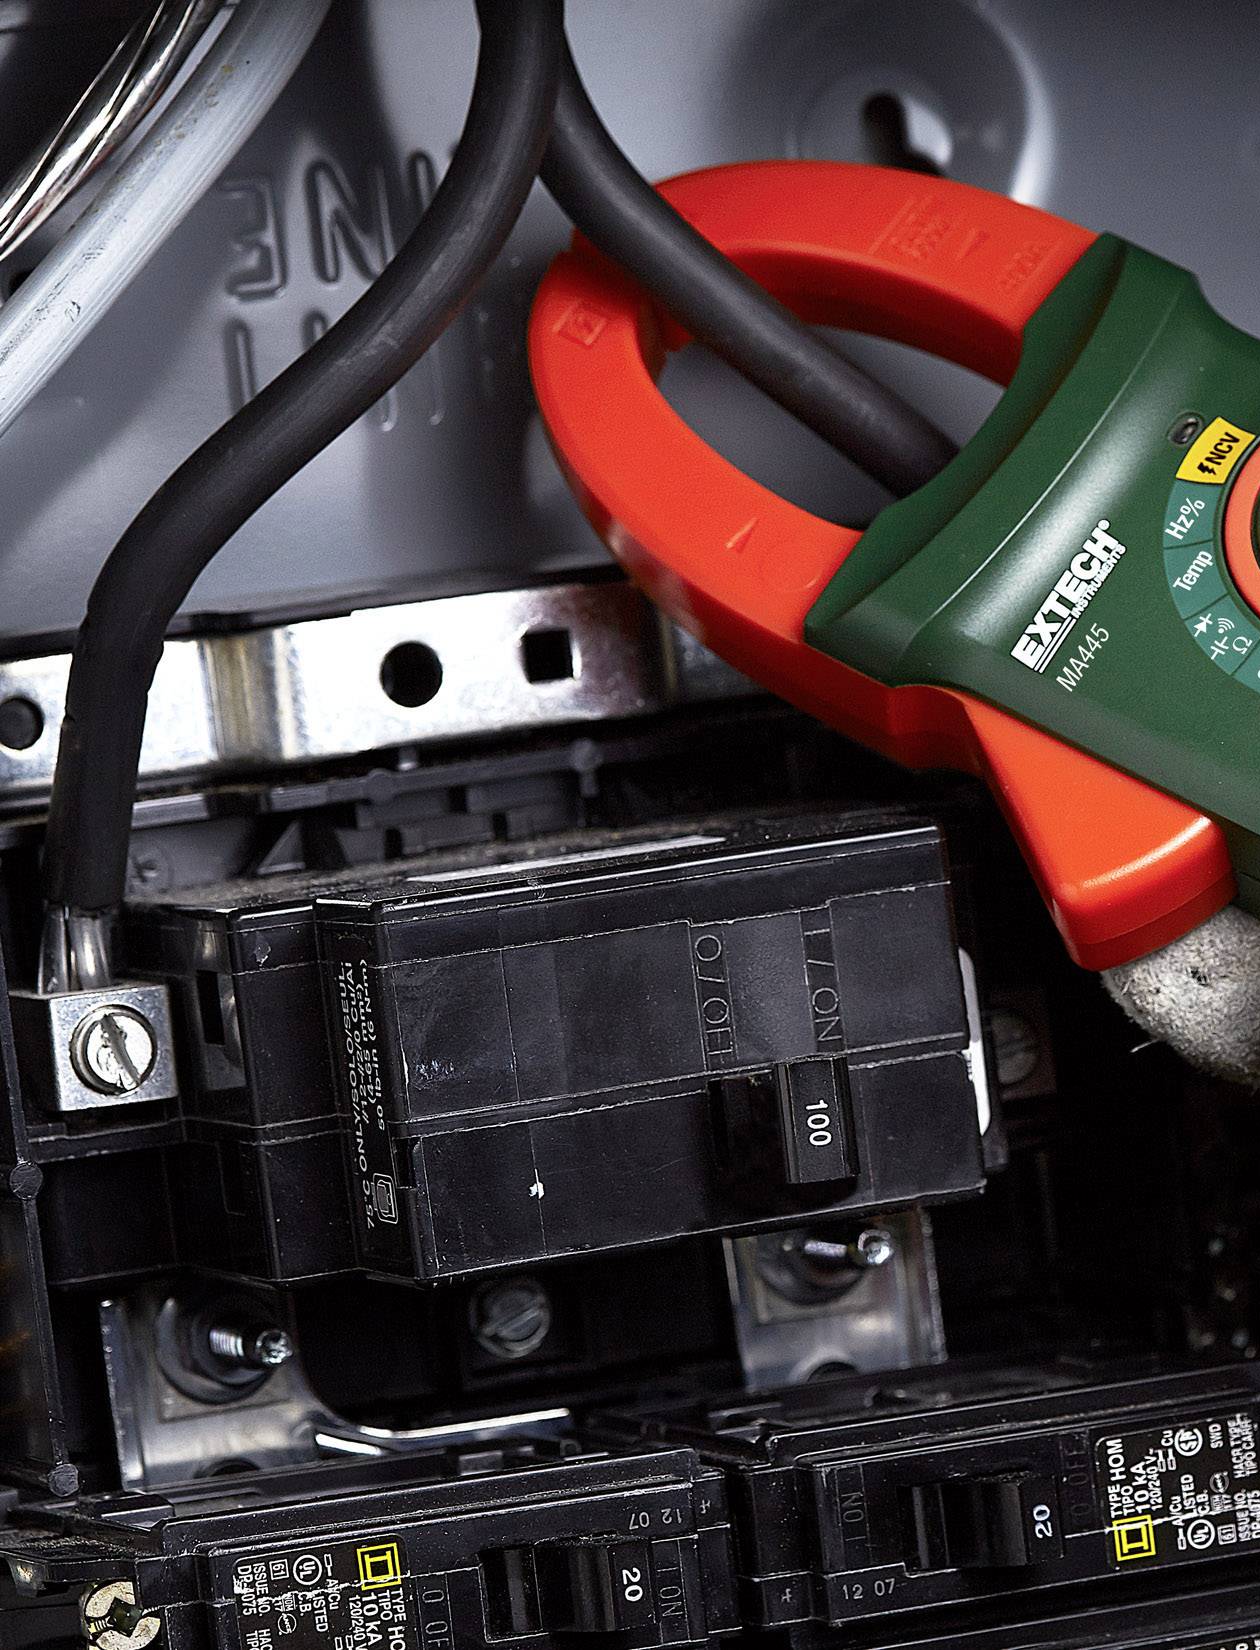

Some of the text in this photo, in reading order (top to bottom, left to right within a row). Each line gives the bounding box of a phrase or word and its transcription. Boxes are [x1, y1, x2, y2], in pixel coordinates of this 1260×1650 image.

[1205, 432, 1240, 466] NCV
[1164, 497, 1206, 540] Hz%
[1070, 543, 1127, 619] INSTRUMENTS
[1172, 550, 1214, 591] Temp
[1010, 522, 1119, 670] EXTECH
[1056, 623, 1110, 692] MA445
[345, 962, 359, 1023] Cu/Al
[367, 1020, 377, 1041] (6
[812, 987, 843, 1042] ON
[371, 1048, 382, 1097] lb-in
[376, 1104, 385, 1131] 50
[805, 1099, 832, 1147] 100
[362, 1179, 375, 1229] 75°C
[1161, 1429, 1174, 1447] Cu
[1208, 1423, 1224, 1449] SWD
[1106, 1438, 1127, 1519] TYPE HOM
[1129, 1461, 1151, 1514] 10 kA
[1146, 1466, 1163, 1511] 120/240
[1180, 1473, 1197, 1518] LISTED
[628, 1507, 682, 1530] 12 07
[1032, 1503, 1053, 1539] 20
[1120, 1484, 1136, 1517] TIPO
[1233, 1488, 1251, 1543] ISSUE NO.
[252, 1562, 269, 1596] ISSUE
[621, 1566, 644, 1602] 20
[842, 1578, 896, 1600] 12 07
[348, 1593, 367, 1642] 120/240
[361, 1590, 383, 1647] 10 kA
[377, 1589, 394, 1621] TIPO
[387, 1587, 407, 1650] TYPE HO
[659, 1585, 684, 1617] ON
[257, 1628, 273, 1650] HAC
[425, 1620, 449, 1650] OF
